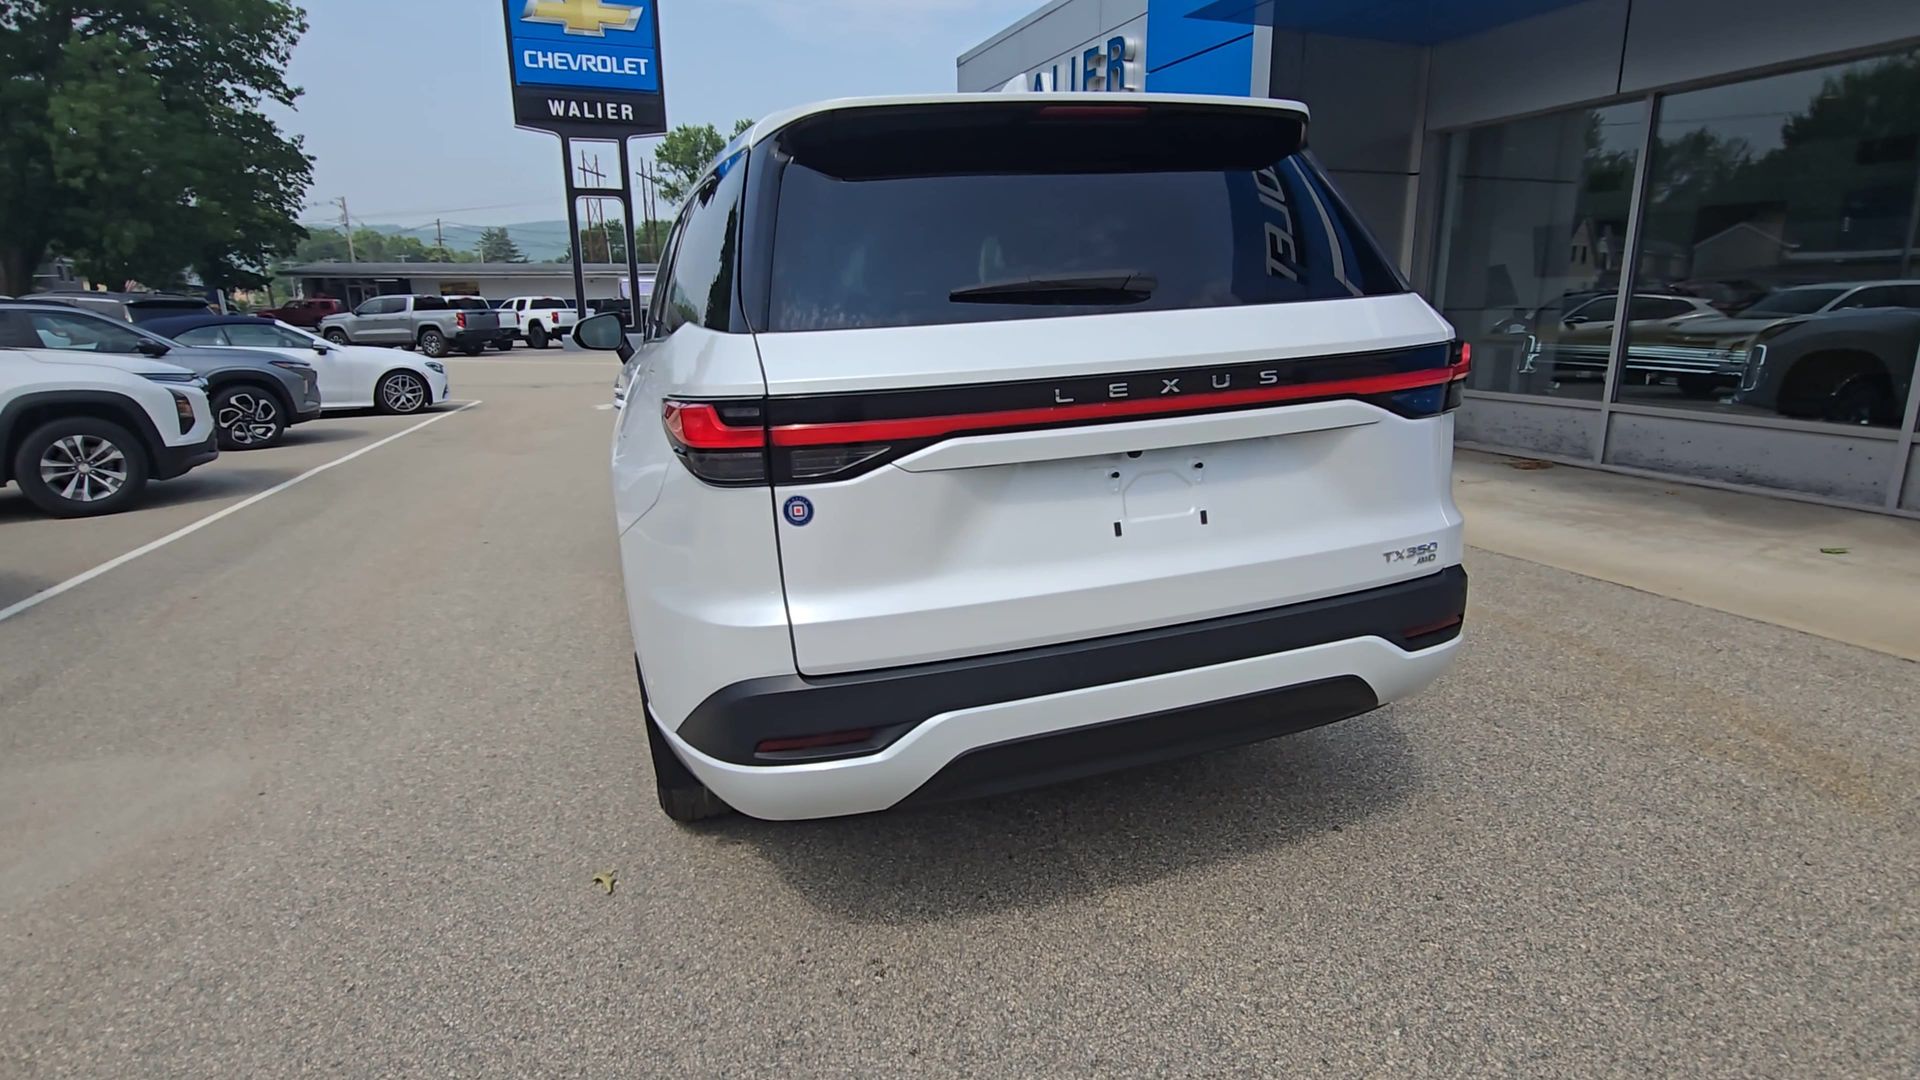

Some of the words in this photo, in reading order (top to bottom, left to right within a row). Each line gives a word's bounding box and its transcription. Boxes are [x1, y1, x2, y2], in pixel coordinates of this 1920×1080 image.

[523, 50, 648, 75] CHEVROLET
[548, 99, 633, 120] WALIER
[1055, 370, 1278, 403] LEXUS
